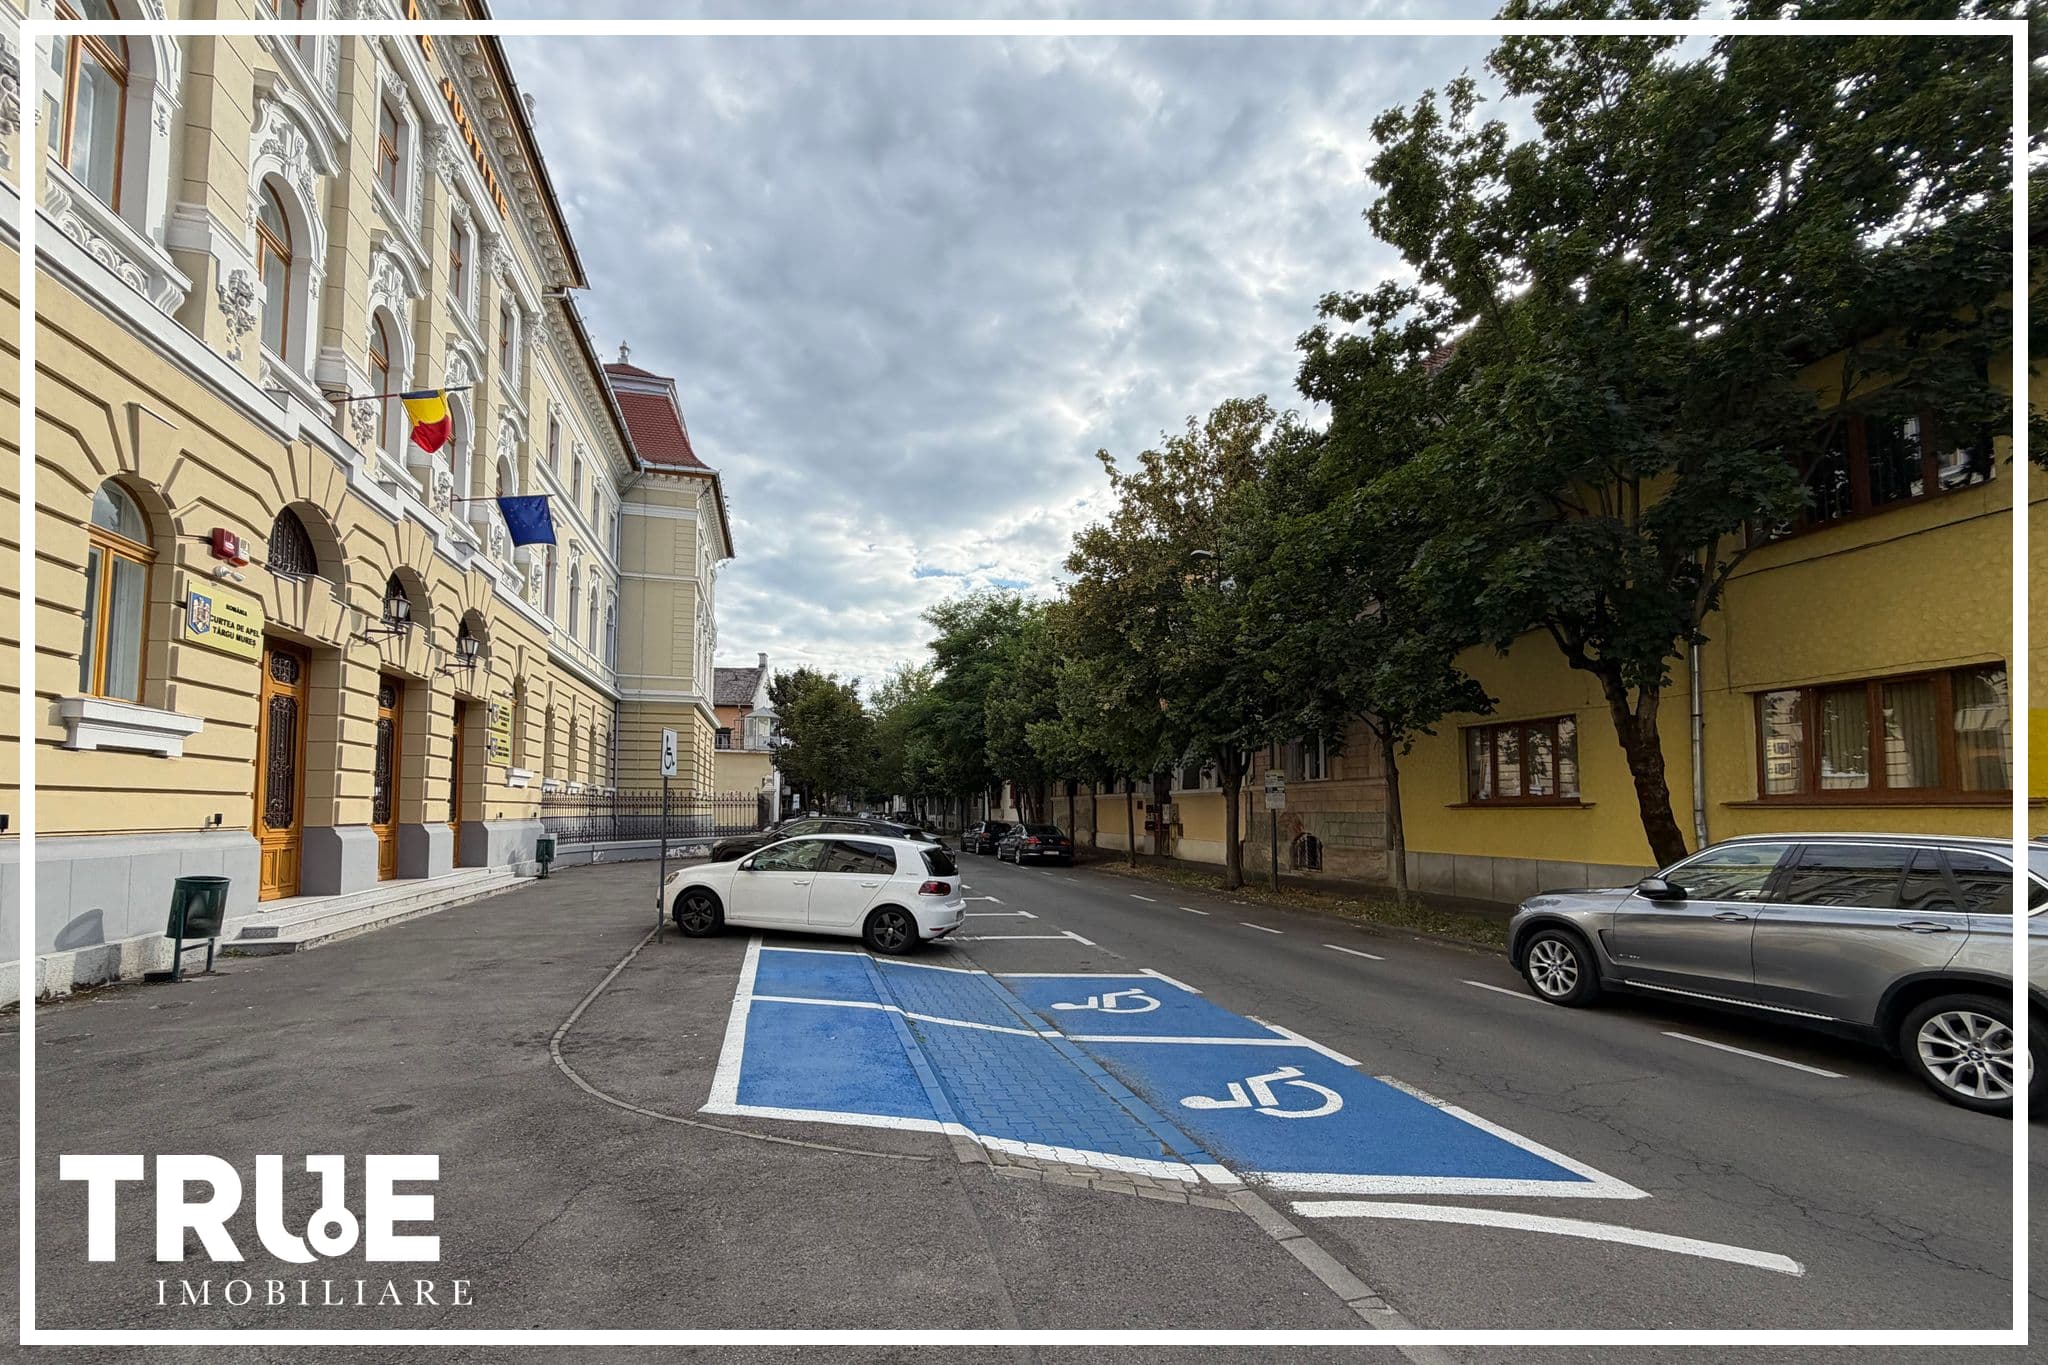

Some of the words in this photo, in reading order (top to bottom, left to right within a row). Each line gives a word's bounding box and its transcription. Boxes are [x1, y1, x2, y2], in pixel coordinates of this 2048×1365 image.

[210, 614, 235, 629] CURTEA
[236, 623, 245, 633] DE
[245, 627, 260, 638] APEL
